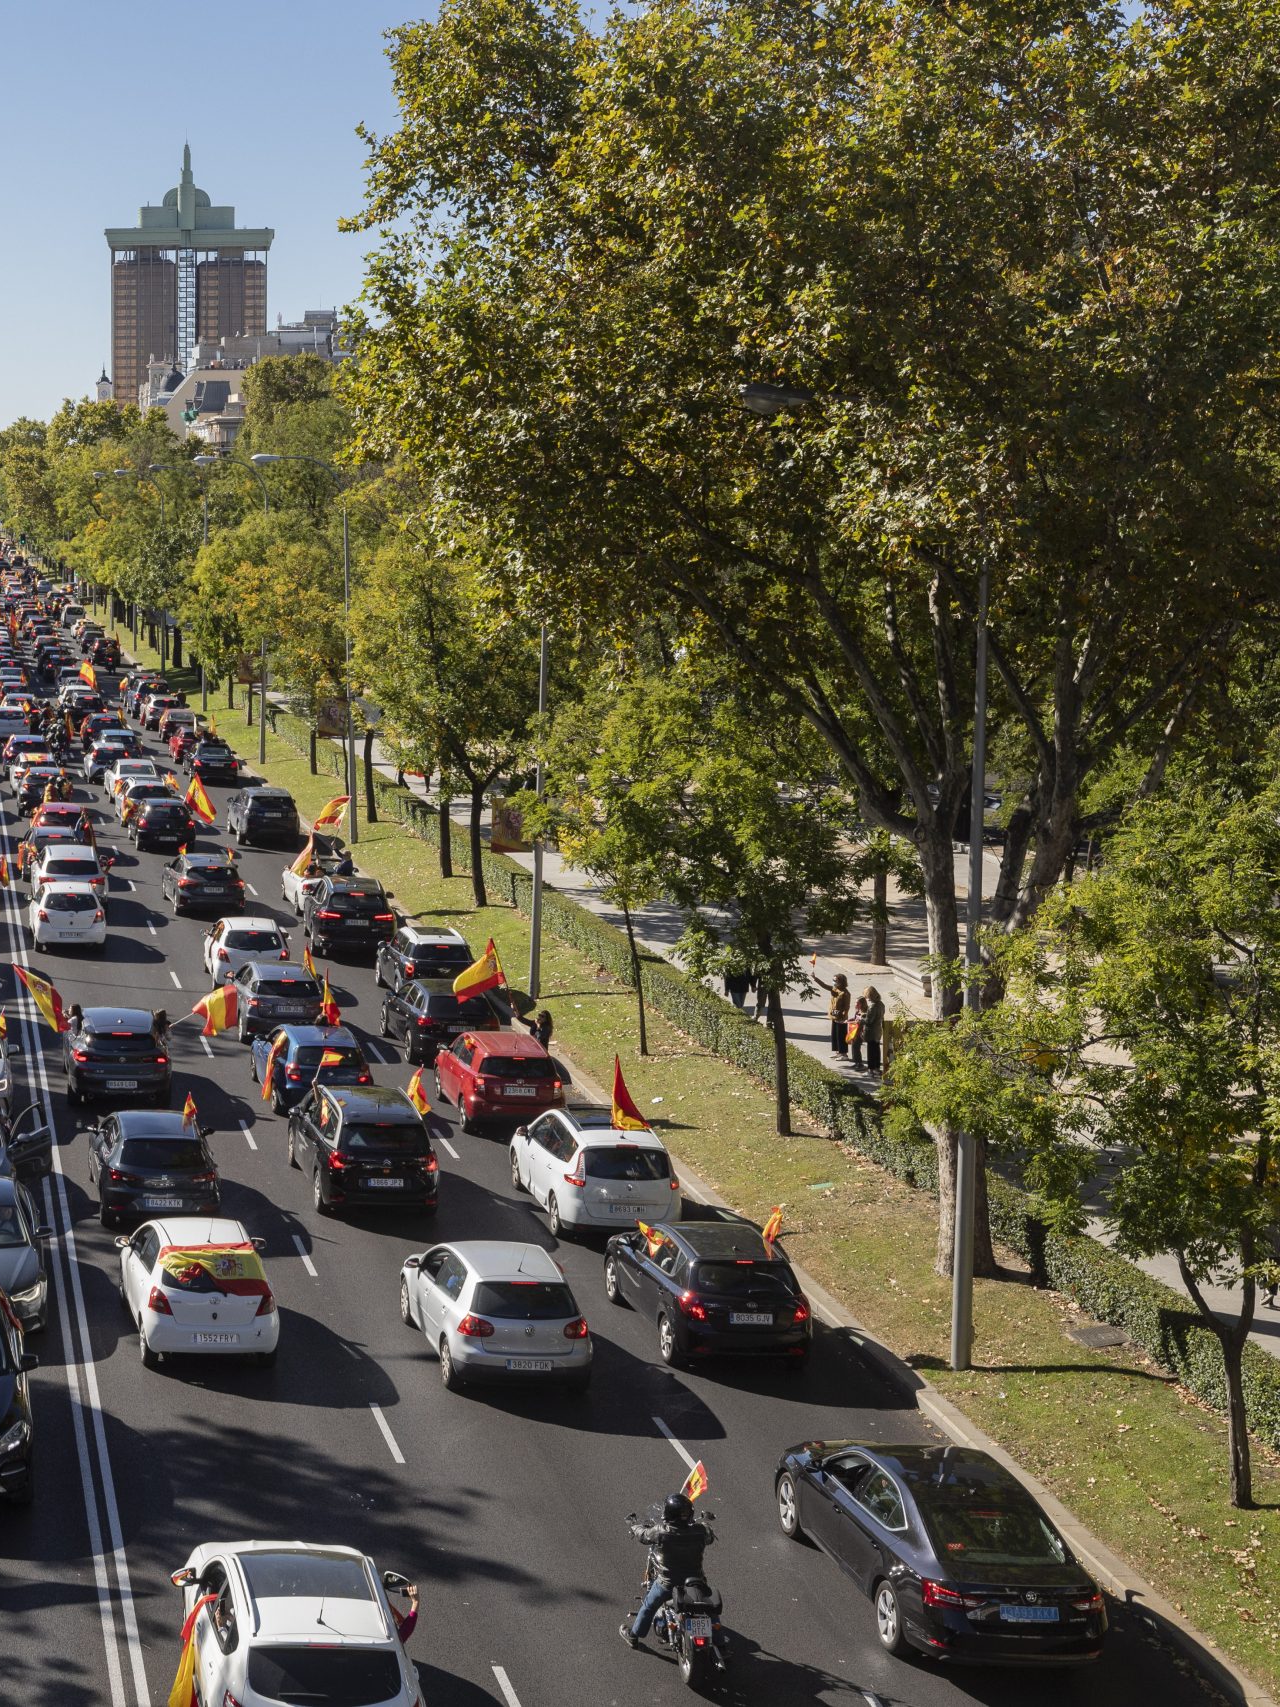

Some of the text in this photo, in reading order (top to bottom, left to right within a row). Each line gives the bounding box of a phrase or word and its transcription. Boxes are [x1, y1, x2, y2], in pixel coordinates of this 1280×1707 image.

[735, 1313, 770, 1322] 8035 GJV
[200, 1334, 234, 1342] 1552 FRY
[512, 1360, 532, 1369] 3820
[691, 1619, 710, 1628] 8851
